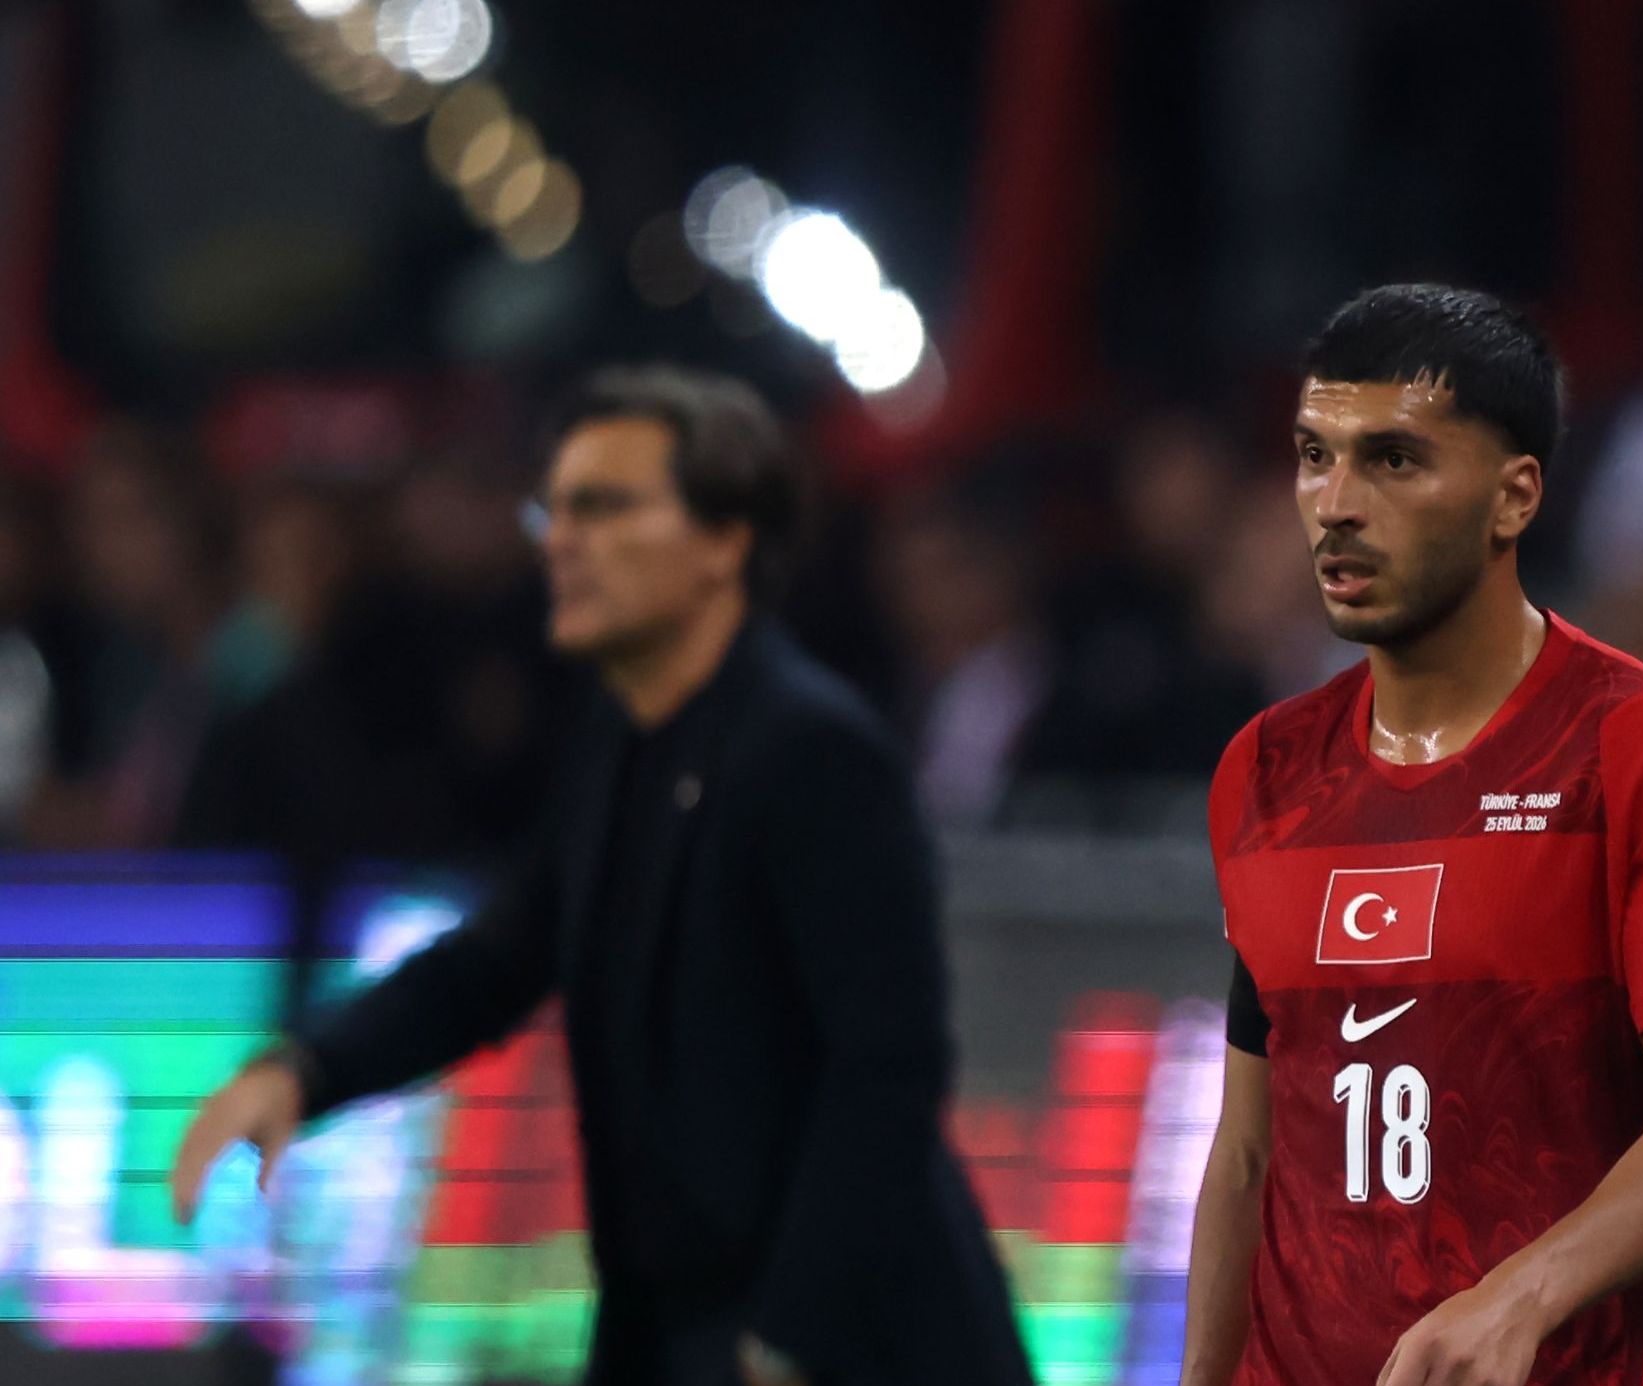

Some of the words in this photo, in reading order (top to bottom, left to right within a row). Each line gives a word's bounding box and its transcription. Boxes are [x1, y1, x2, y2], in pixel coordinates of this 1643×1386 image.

[1480, 792, 1520, 810] TÜRKİYE
[1484, 816, 1497, 832] 25
[1496, 813, 1523, 831] EYLÜL
[1333, 1063, 1431, 1204] 18
